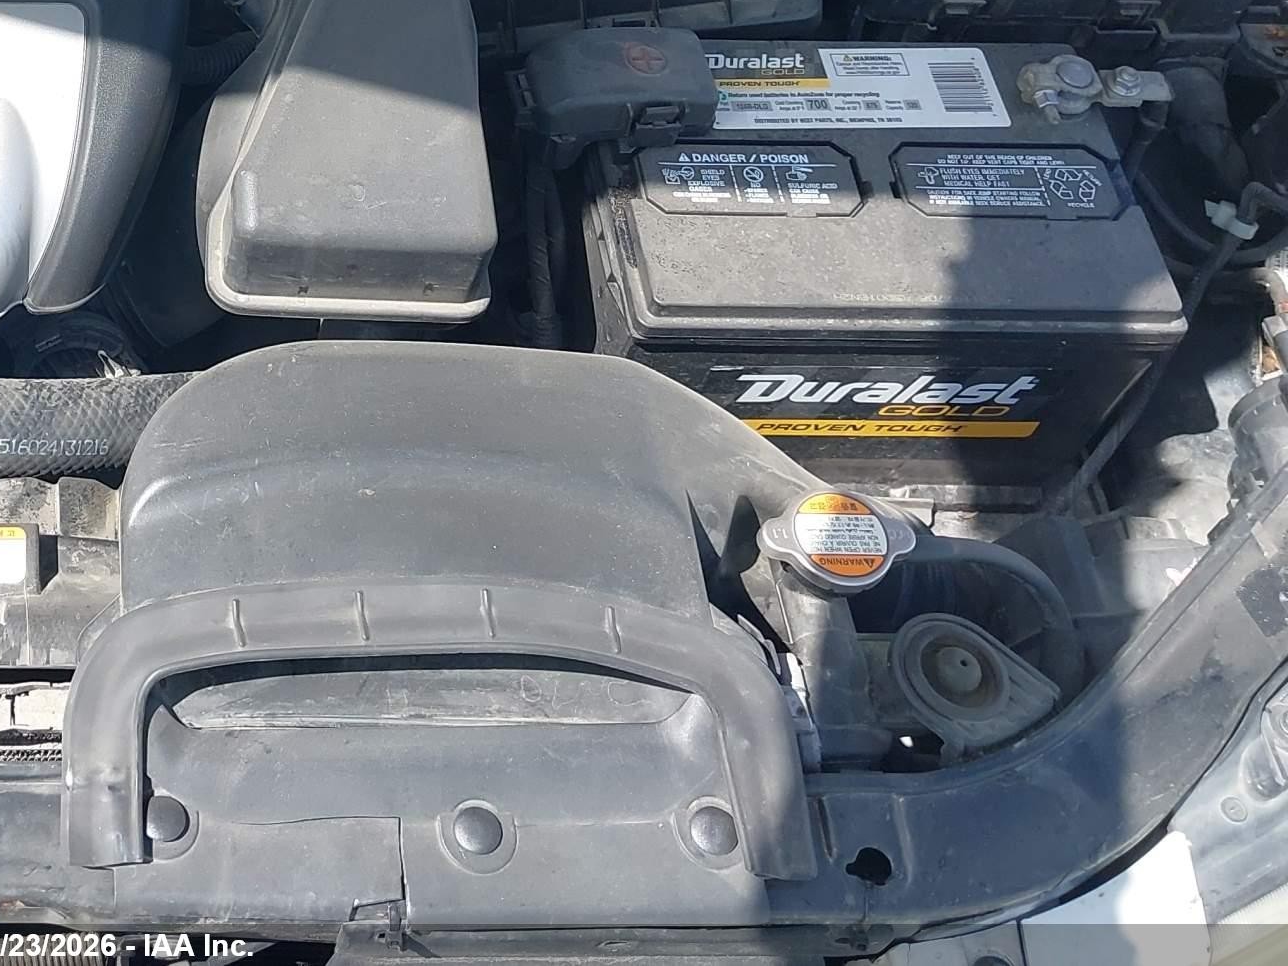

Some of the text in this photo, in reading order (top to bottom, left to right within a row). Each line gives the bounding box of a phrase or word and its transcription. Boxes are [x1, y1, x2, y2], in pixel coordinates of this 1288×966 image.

[704, 53, 805, 69] Duralast
[807, 99, 827, 108] 700
[692, 153, 808, 163] DANGER / POISON
[736, 374, 1037, 404] Duralast
[878, 405, 1010, 417] GOLD
[756, 423, 962, 433] PROVEN TOUGH
